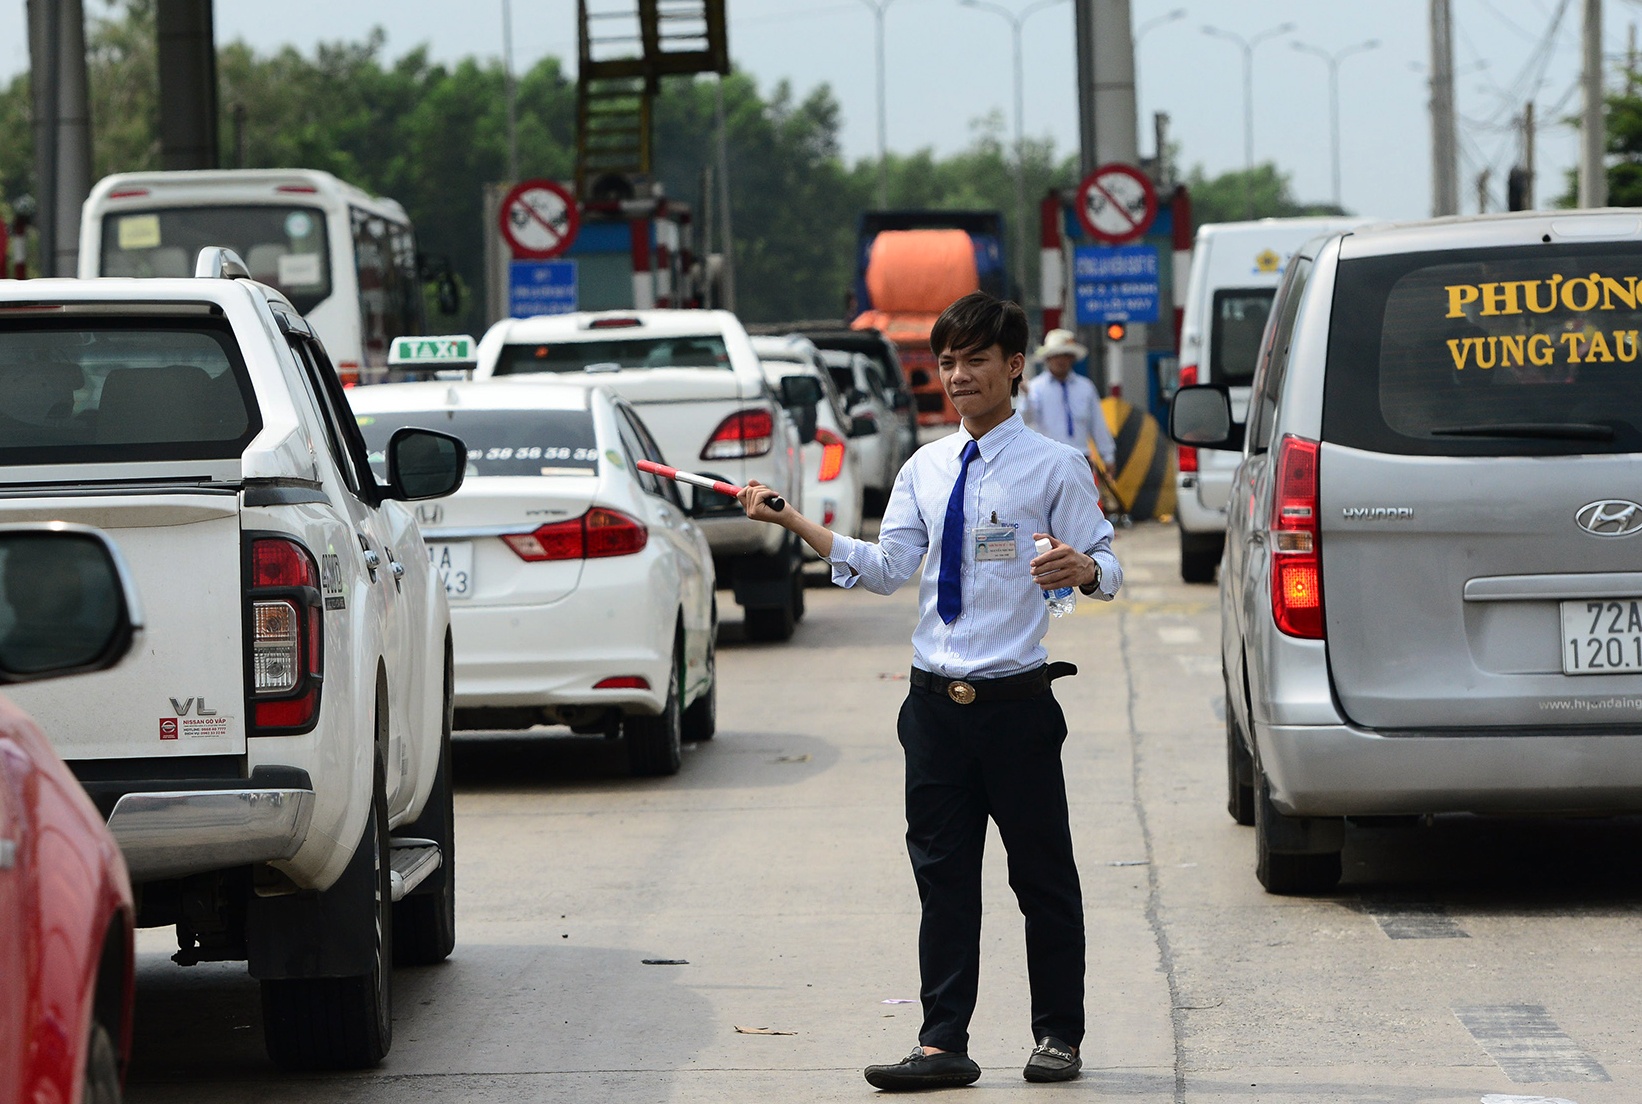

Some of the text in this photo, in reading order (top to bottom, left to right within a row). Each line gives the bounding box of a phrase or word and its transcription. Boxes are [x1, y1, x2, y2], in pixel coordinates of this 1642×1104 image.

[1444, 272, 1642, 319] PHƯƠN
[1446, 329, 1639, 370] VUNG TAU
[1342, 507, 1414, 520] HYUNDAI
[1586, 601, 1642, 634] 72A
[169, 696, 217, 716] VL
